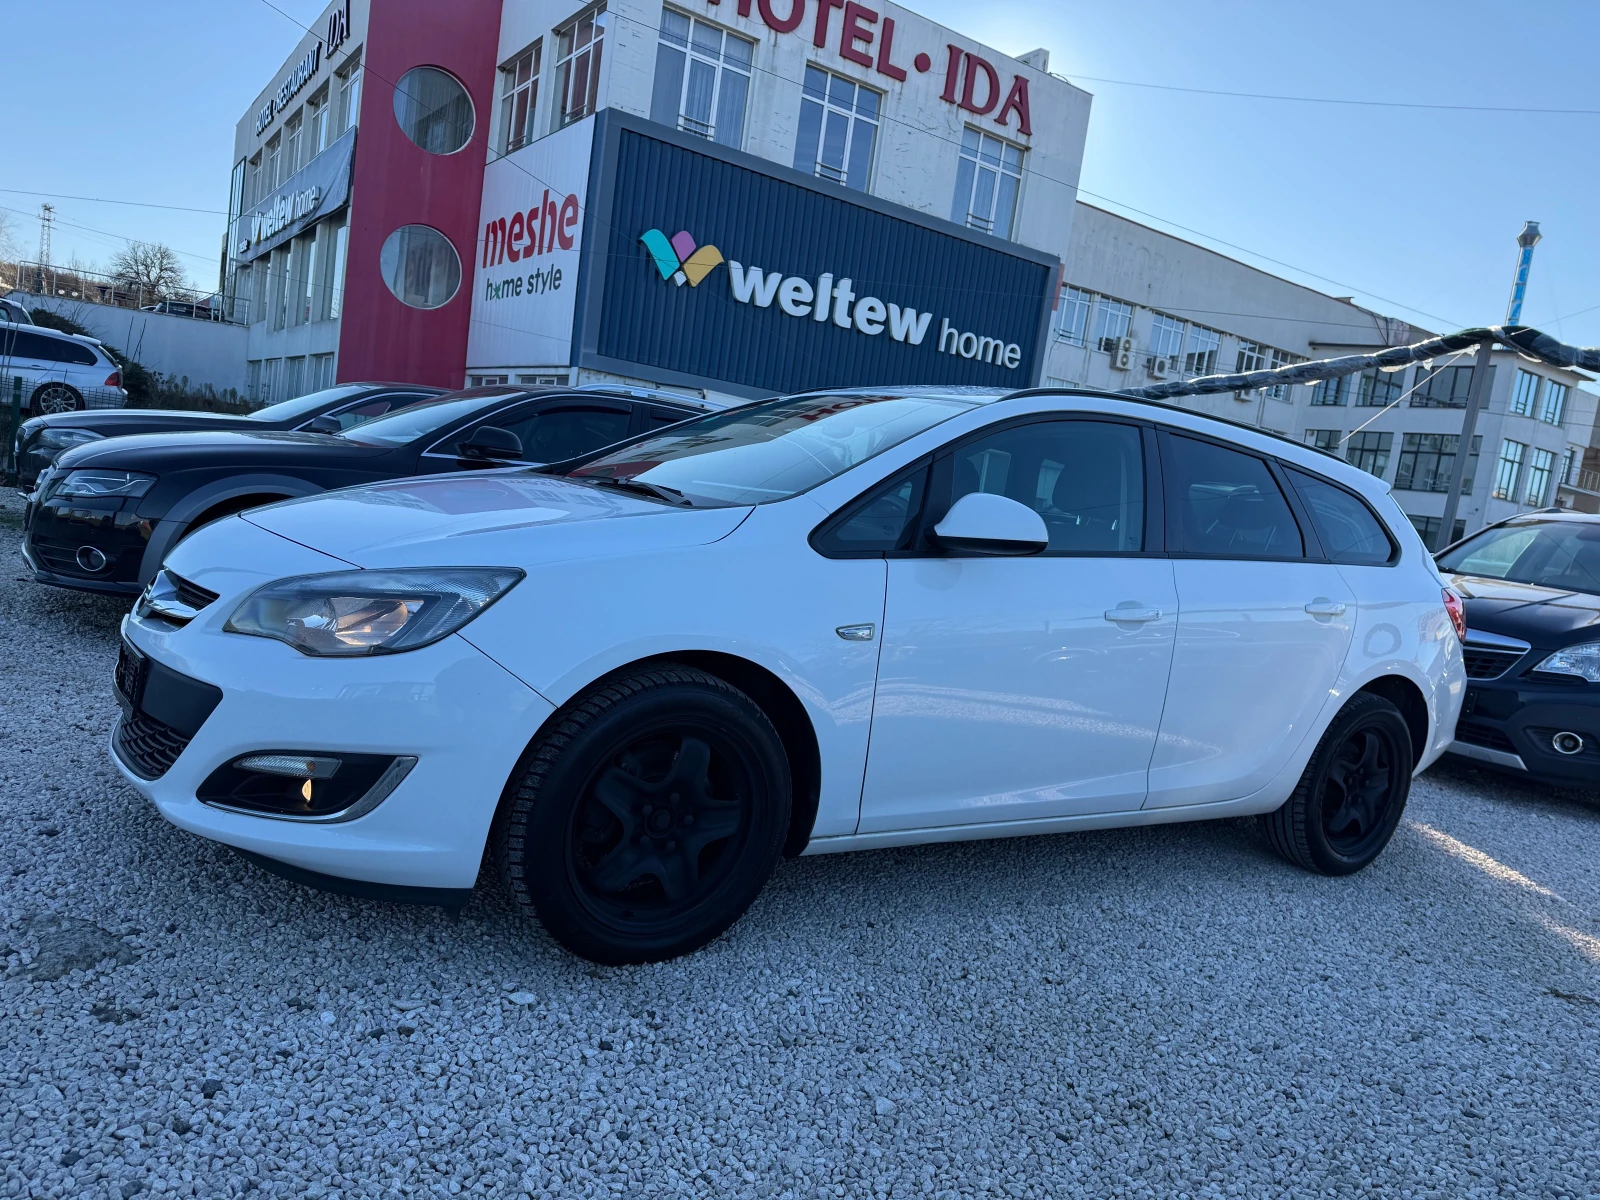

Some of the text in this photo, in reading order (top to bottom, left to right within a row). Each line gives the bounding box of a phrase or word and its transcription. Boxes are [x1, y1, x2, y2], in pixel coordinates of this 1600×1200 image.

[325, 0, 350, 59] IDA
[707, 0, 1033, 136] OTEL IDA
[260, 186, 320, 241] weltew home
[482, 189, 579, 269] meshe
[527, 264, 562, 295] style
[728, 259, 1022, 370] weltew home
